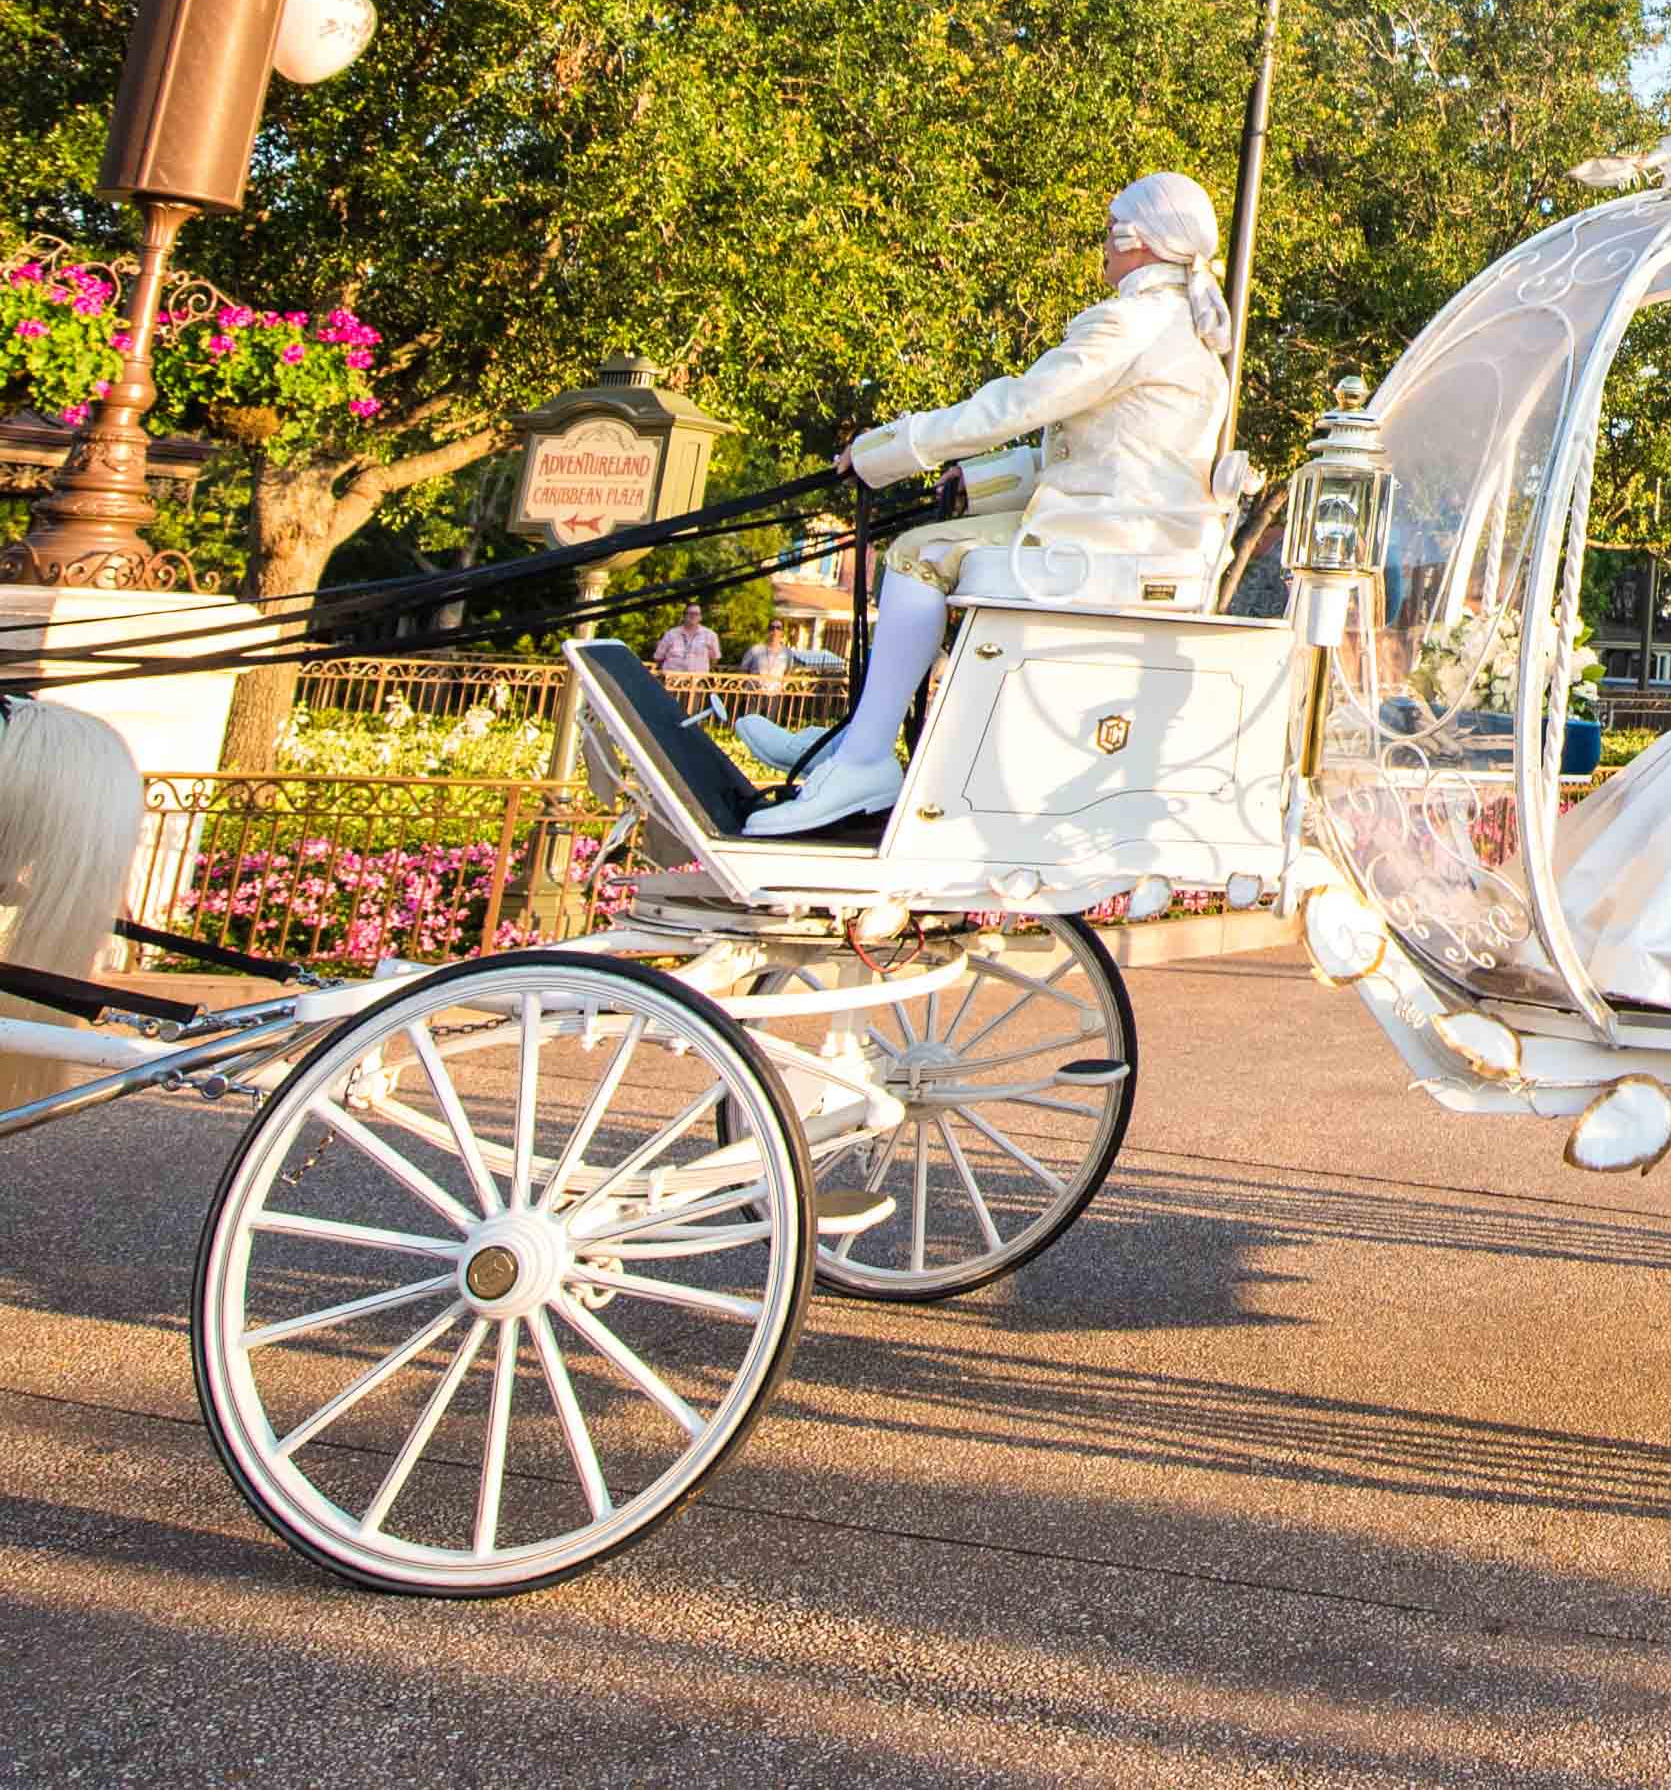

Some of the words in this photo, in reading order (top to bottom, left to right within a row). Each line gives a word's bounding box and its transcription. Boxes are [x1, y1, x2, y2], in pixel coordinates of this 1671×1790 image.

[539, 452, 650, 477] ADVENTURELAND
[532, 487, 601, 506] CARIBBEAN
[606, 488, 644, 506] PLAZA
